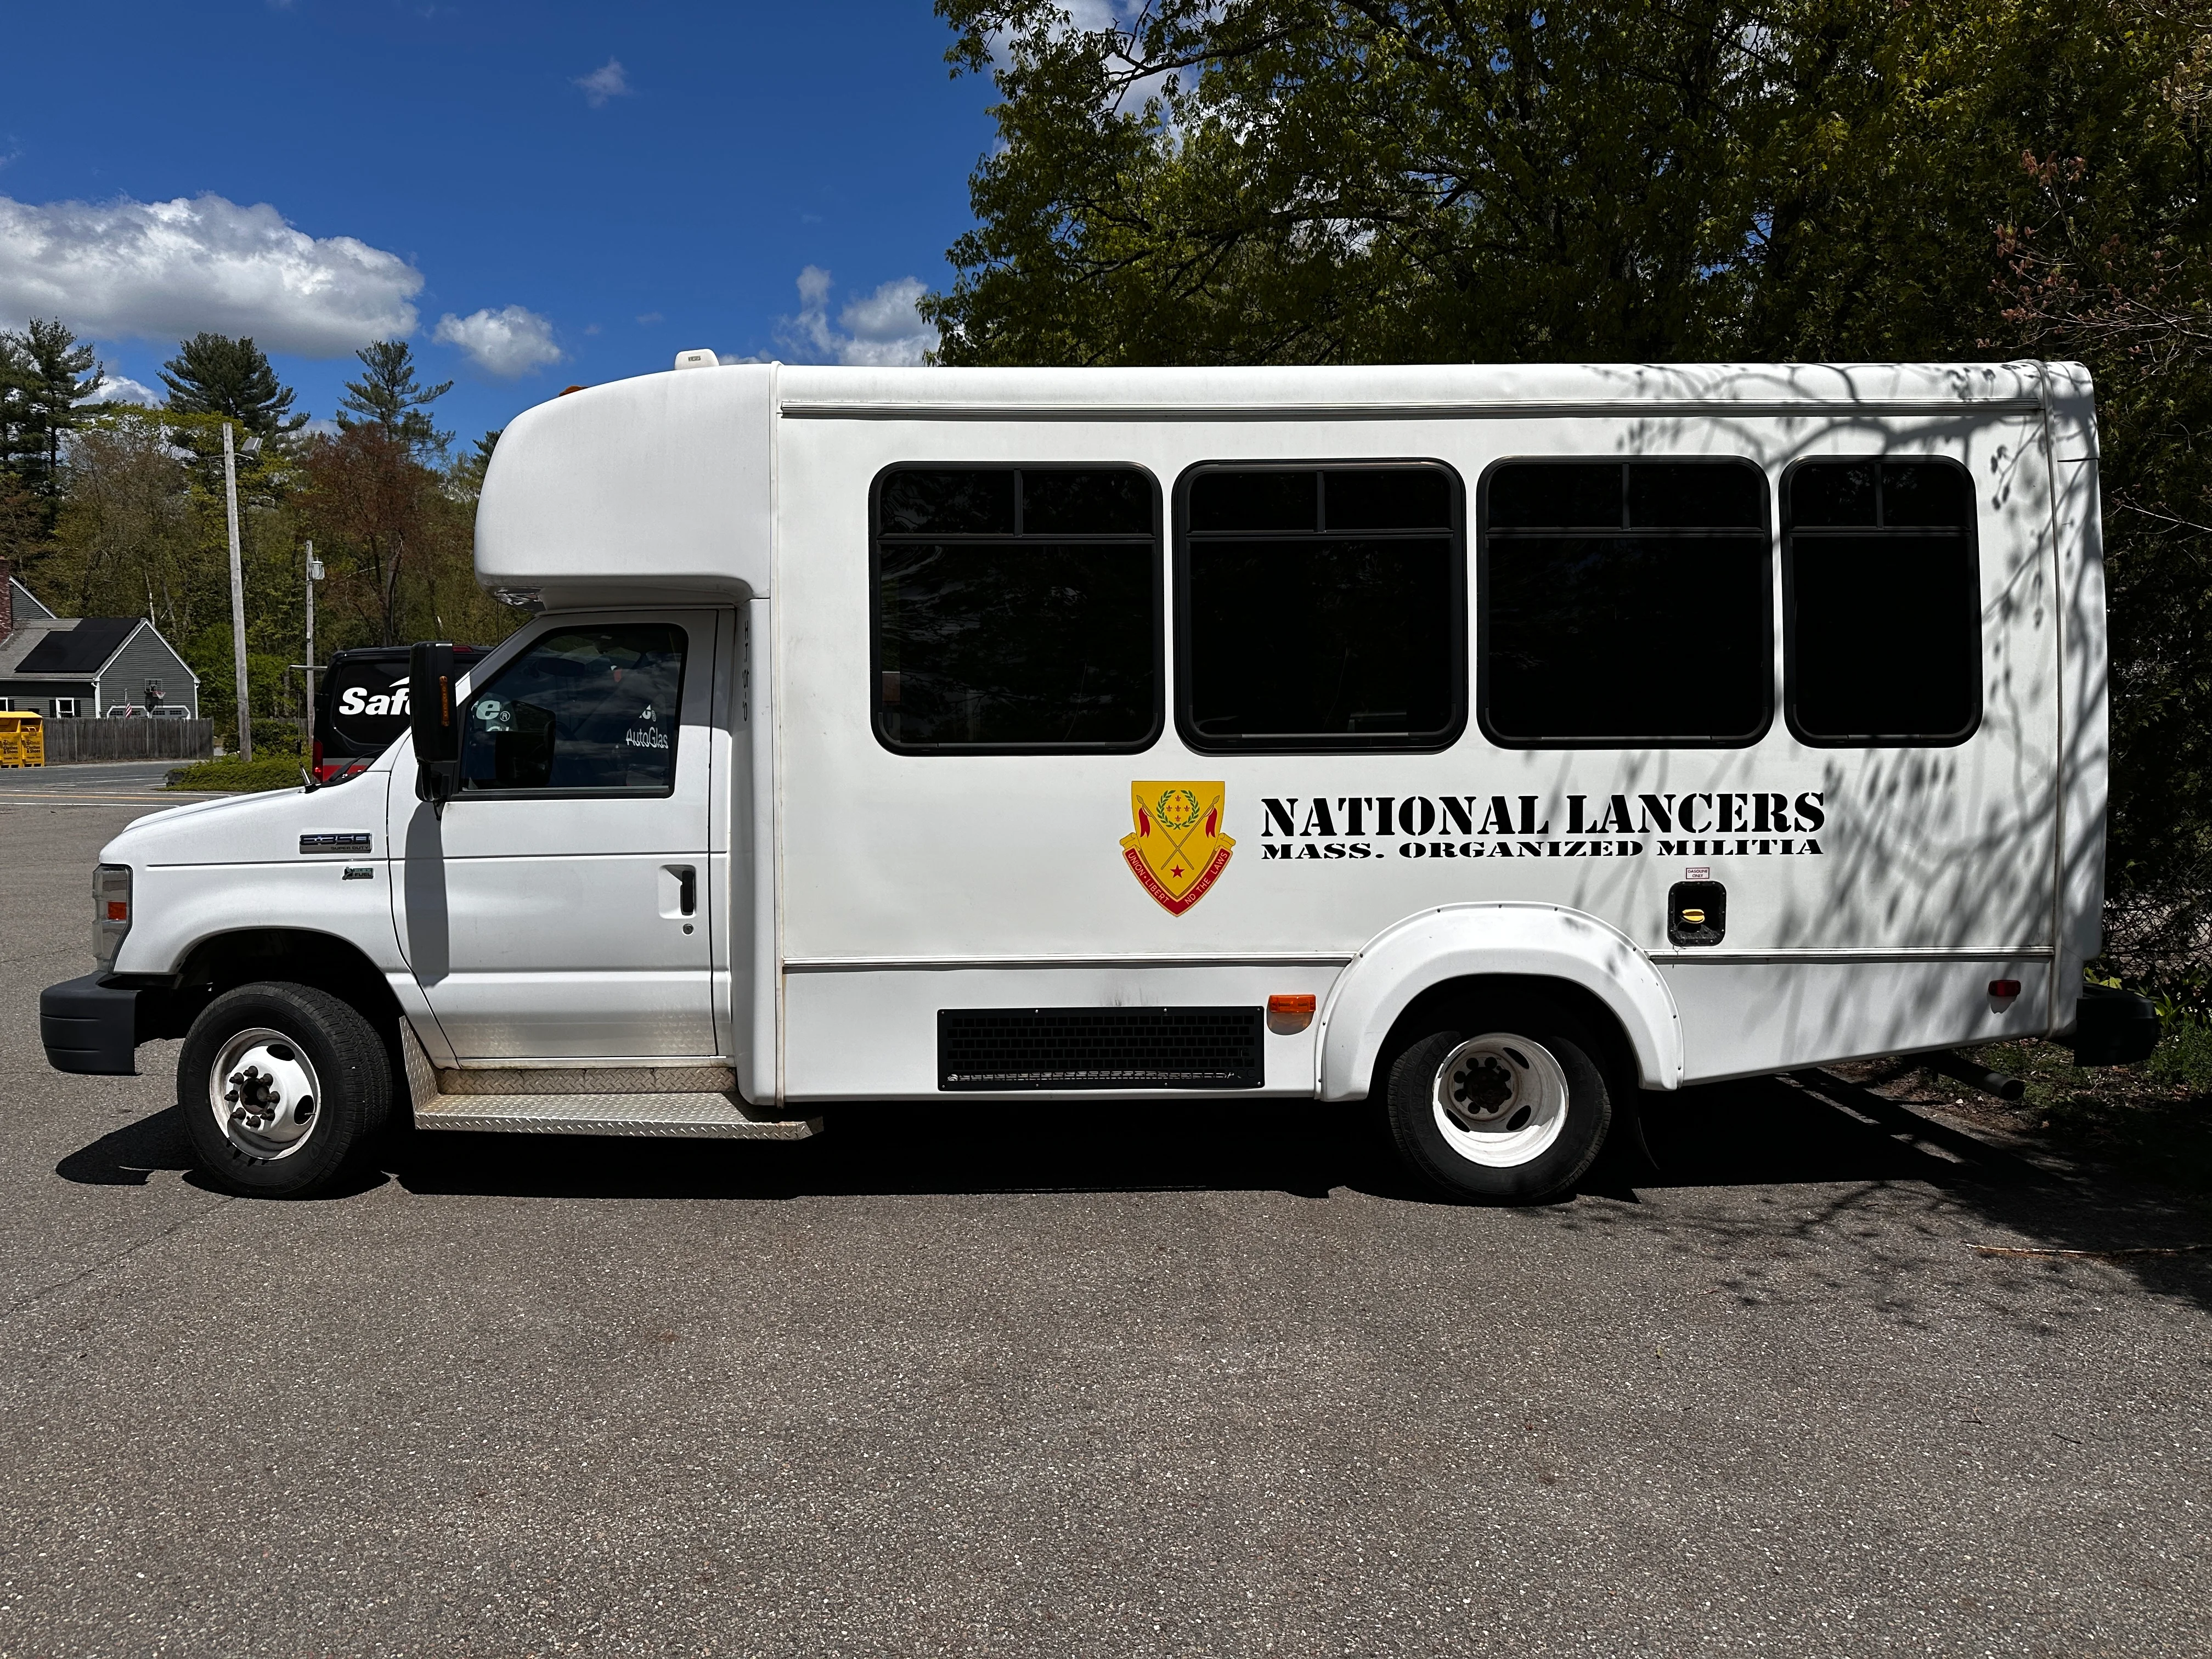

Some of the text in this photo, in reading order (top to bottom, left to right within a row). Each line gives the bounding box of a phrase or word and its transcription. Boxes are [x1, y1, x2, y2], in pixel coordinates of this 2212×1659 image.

[626, 726, 669, 749] AutoGlas
[1261, 792, 1825, 837] NATIONAL LANCERS
[1261, 839, 1824, 860] MASS. ORGANIZED MILITIA
[1128, 852, 1146, 876] UNION
[1195, 877, 1211, 893] THE
[1210, 852, 1228, 874] LAWS
